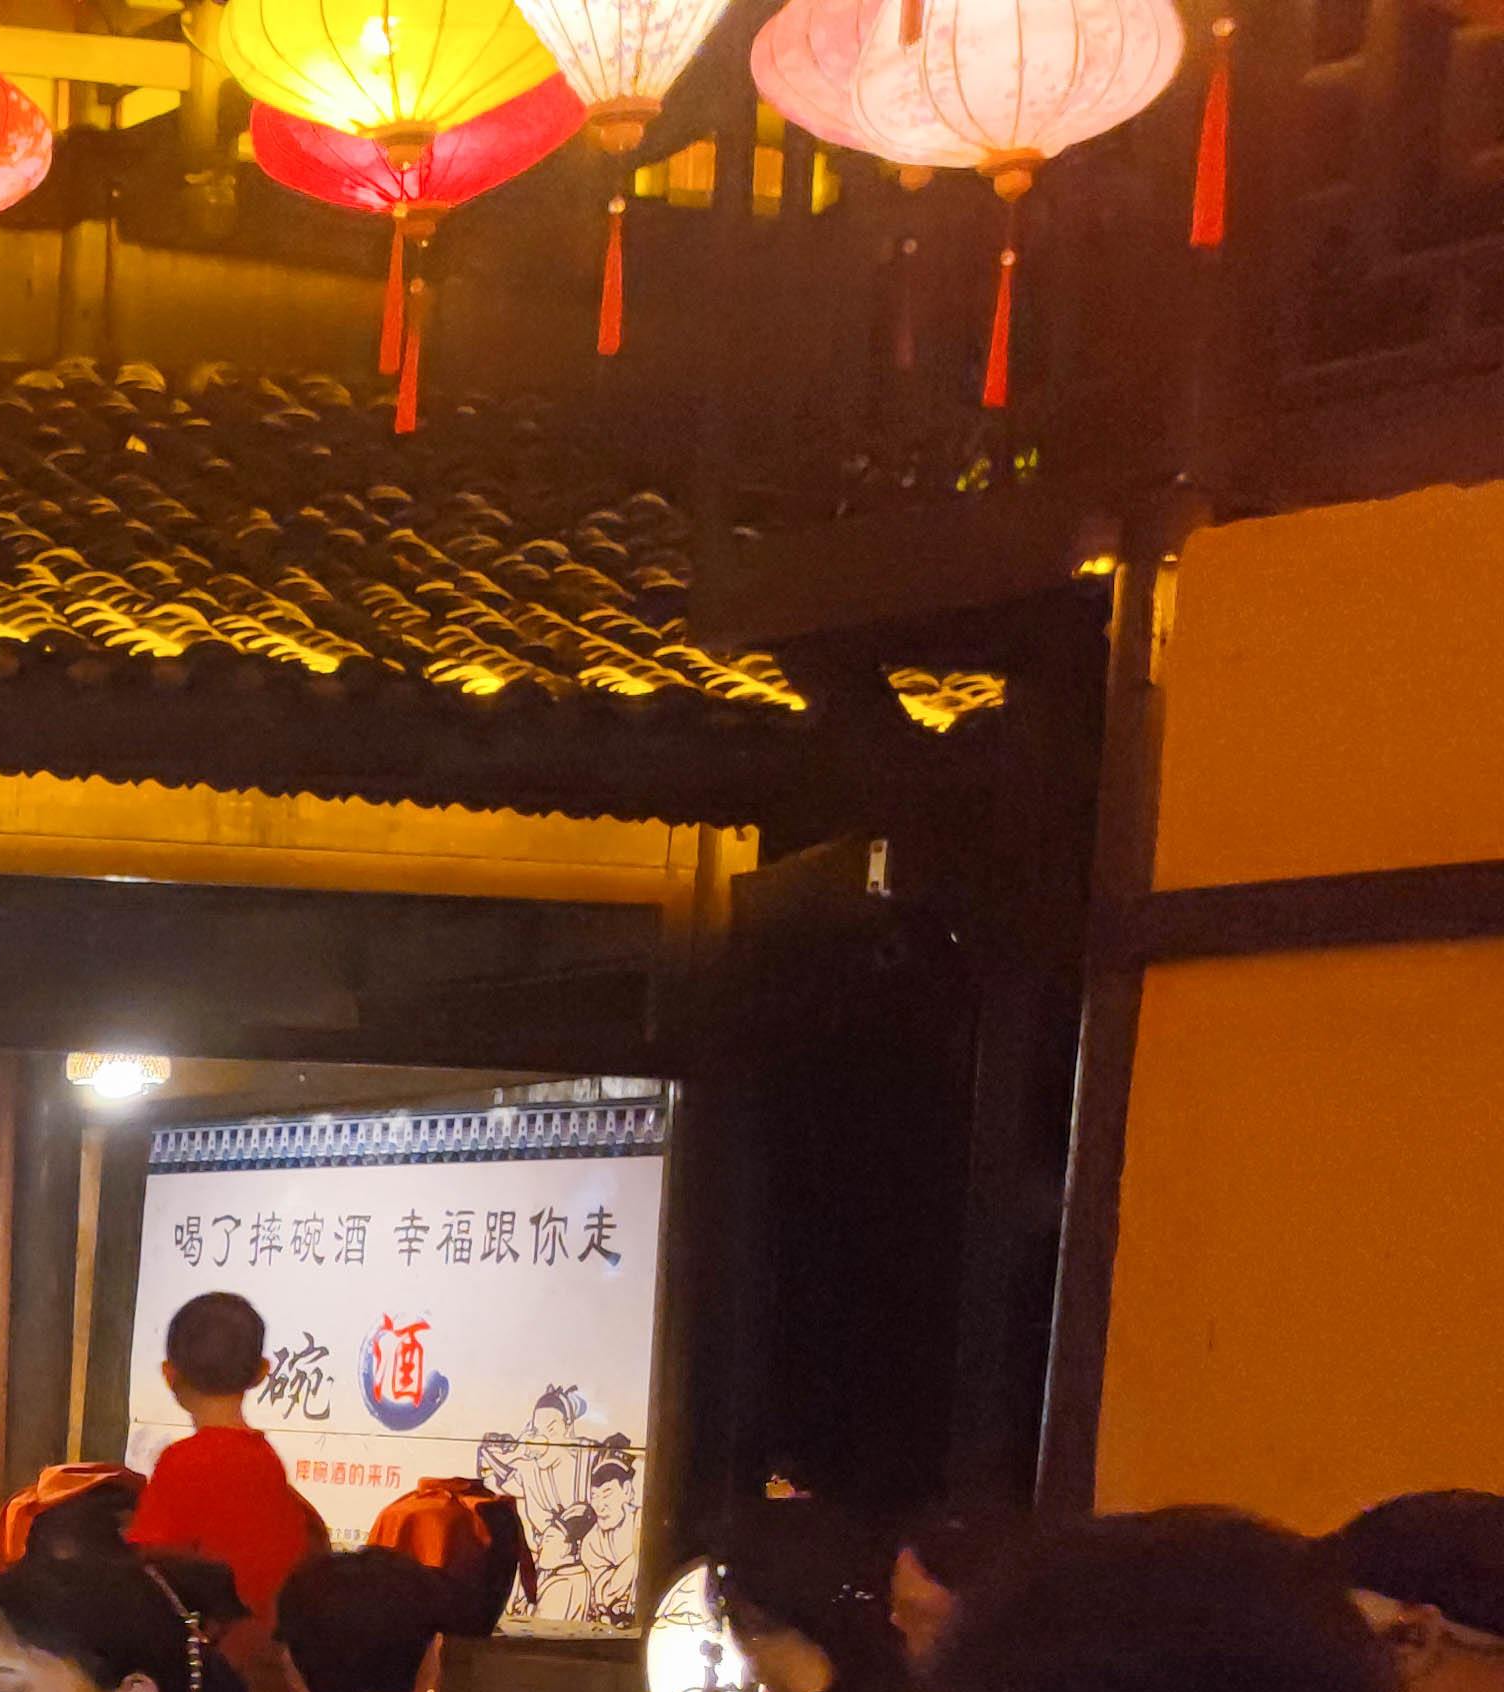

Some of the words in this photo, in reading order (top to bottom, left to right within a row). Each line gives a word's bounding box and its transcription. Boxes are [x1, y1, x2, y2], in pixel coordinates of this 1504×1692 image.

[173, 1211, 371, 1268] 喝了摔碗酒
[393, 1205, 623, 1268] 幸福跟你走
